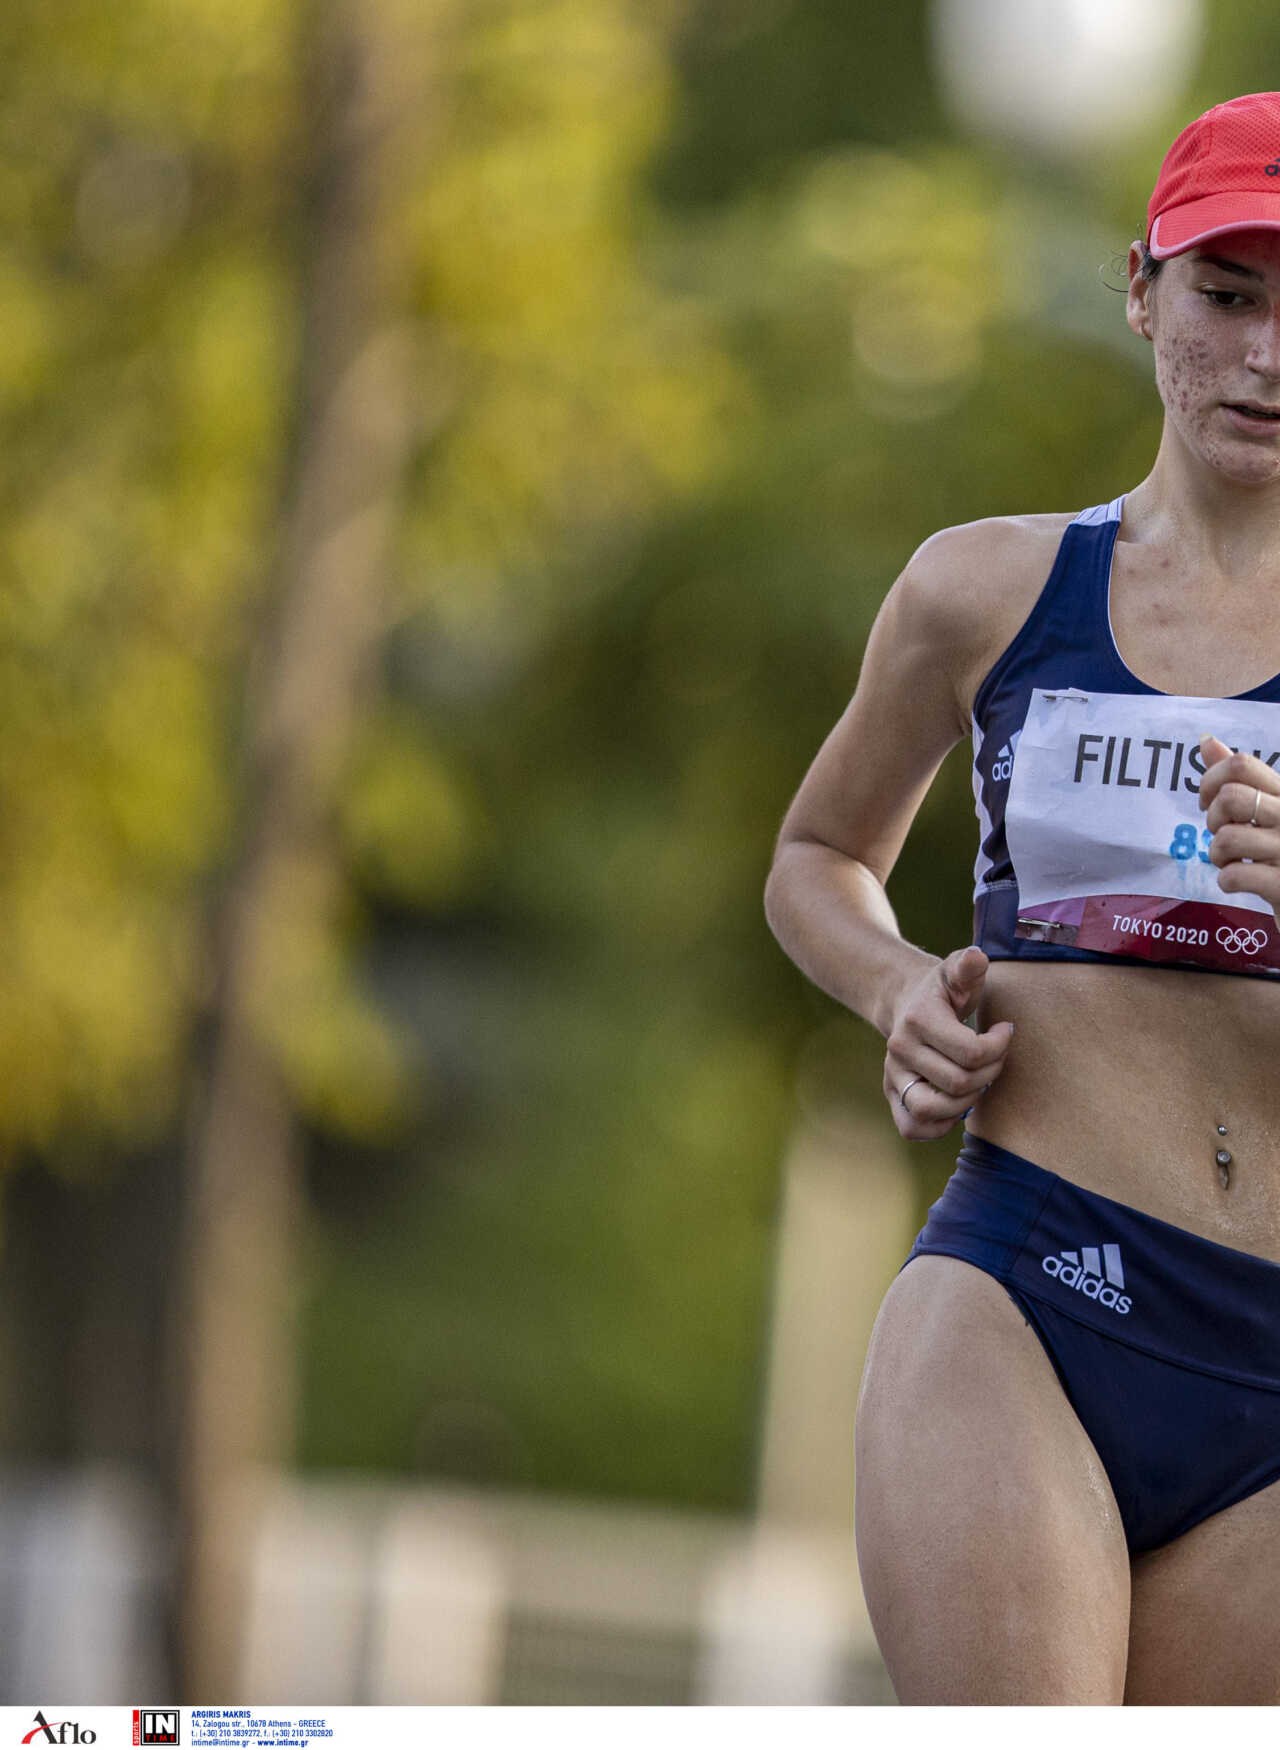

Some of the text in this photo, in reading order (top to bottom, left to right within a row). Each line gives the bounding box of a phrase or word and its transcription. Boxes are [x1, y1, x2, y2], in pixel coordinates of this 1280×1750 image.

[1112, 914, 1209, 946] TOKYO 2020
[1042, 1255, 1133, 1315] adidas
